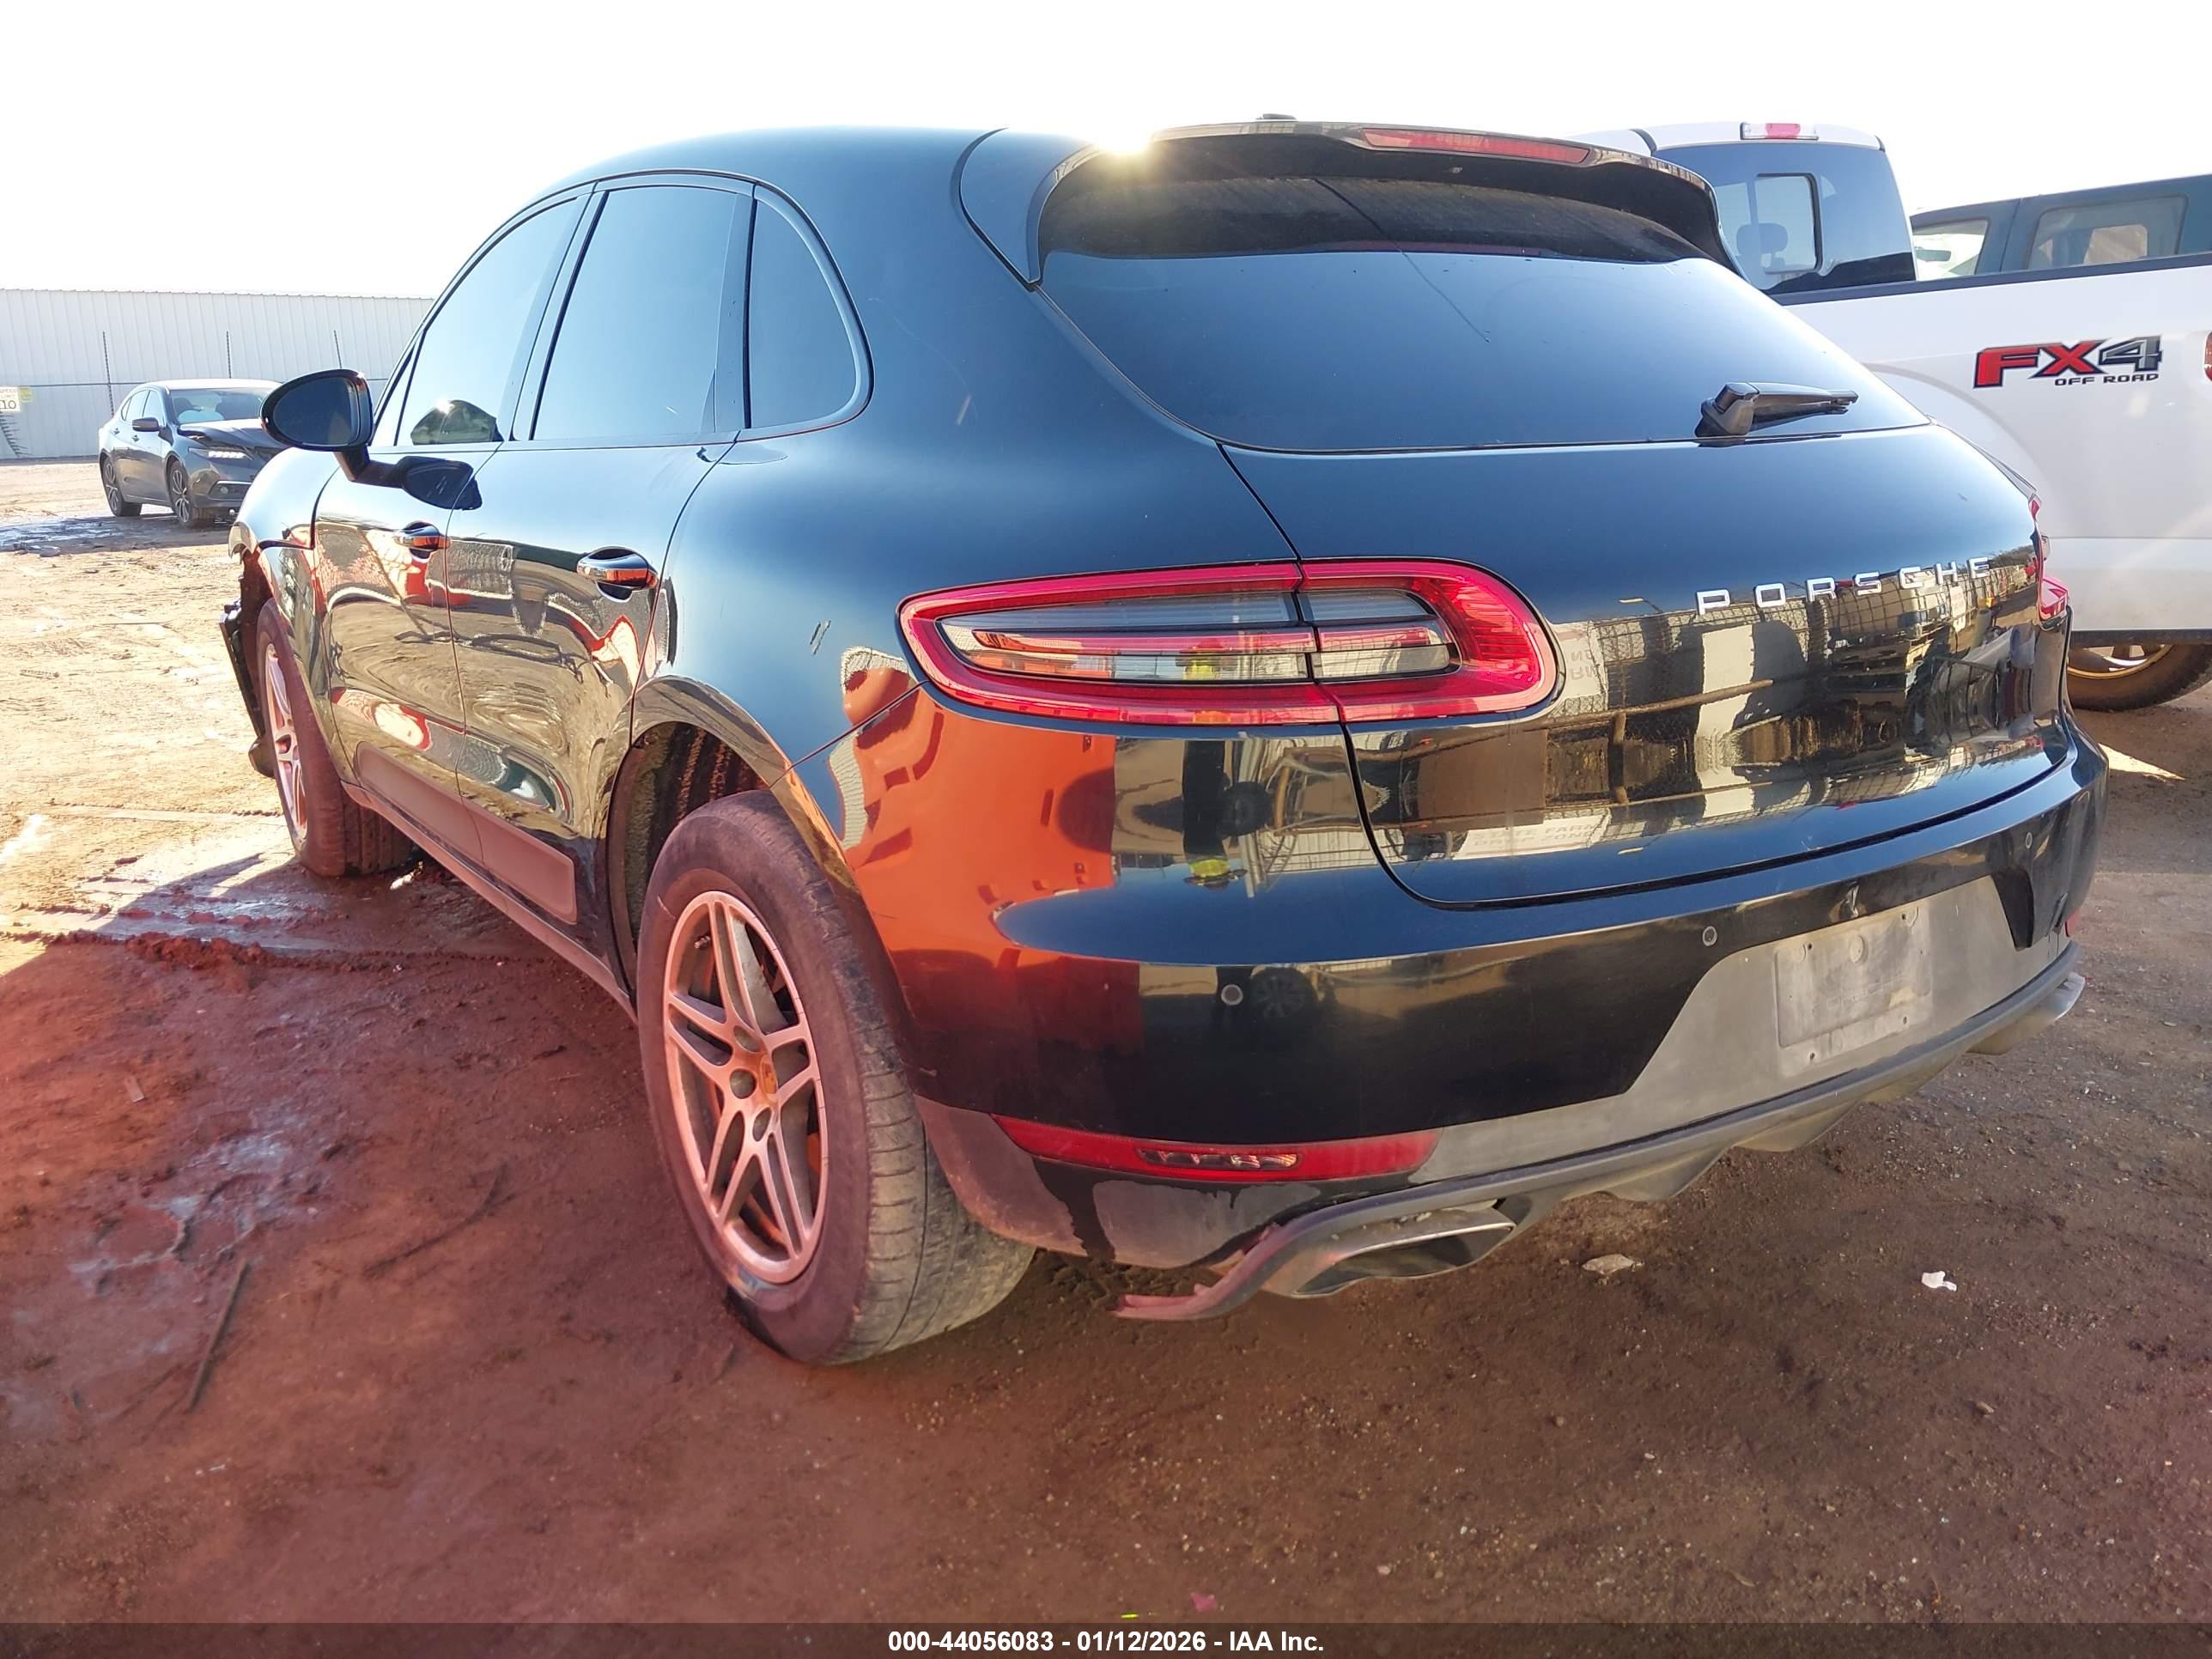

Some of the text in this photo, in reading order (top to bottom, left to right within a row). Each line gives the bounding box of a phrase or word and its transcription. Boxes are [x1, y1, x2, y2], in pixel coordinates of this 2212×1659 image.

[1972, 336, 2163, 389] FX4
[2054, 372, 2160, 386] OFF ROAD
[1697, 556, 1990, 616] PORSCHE
